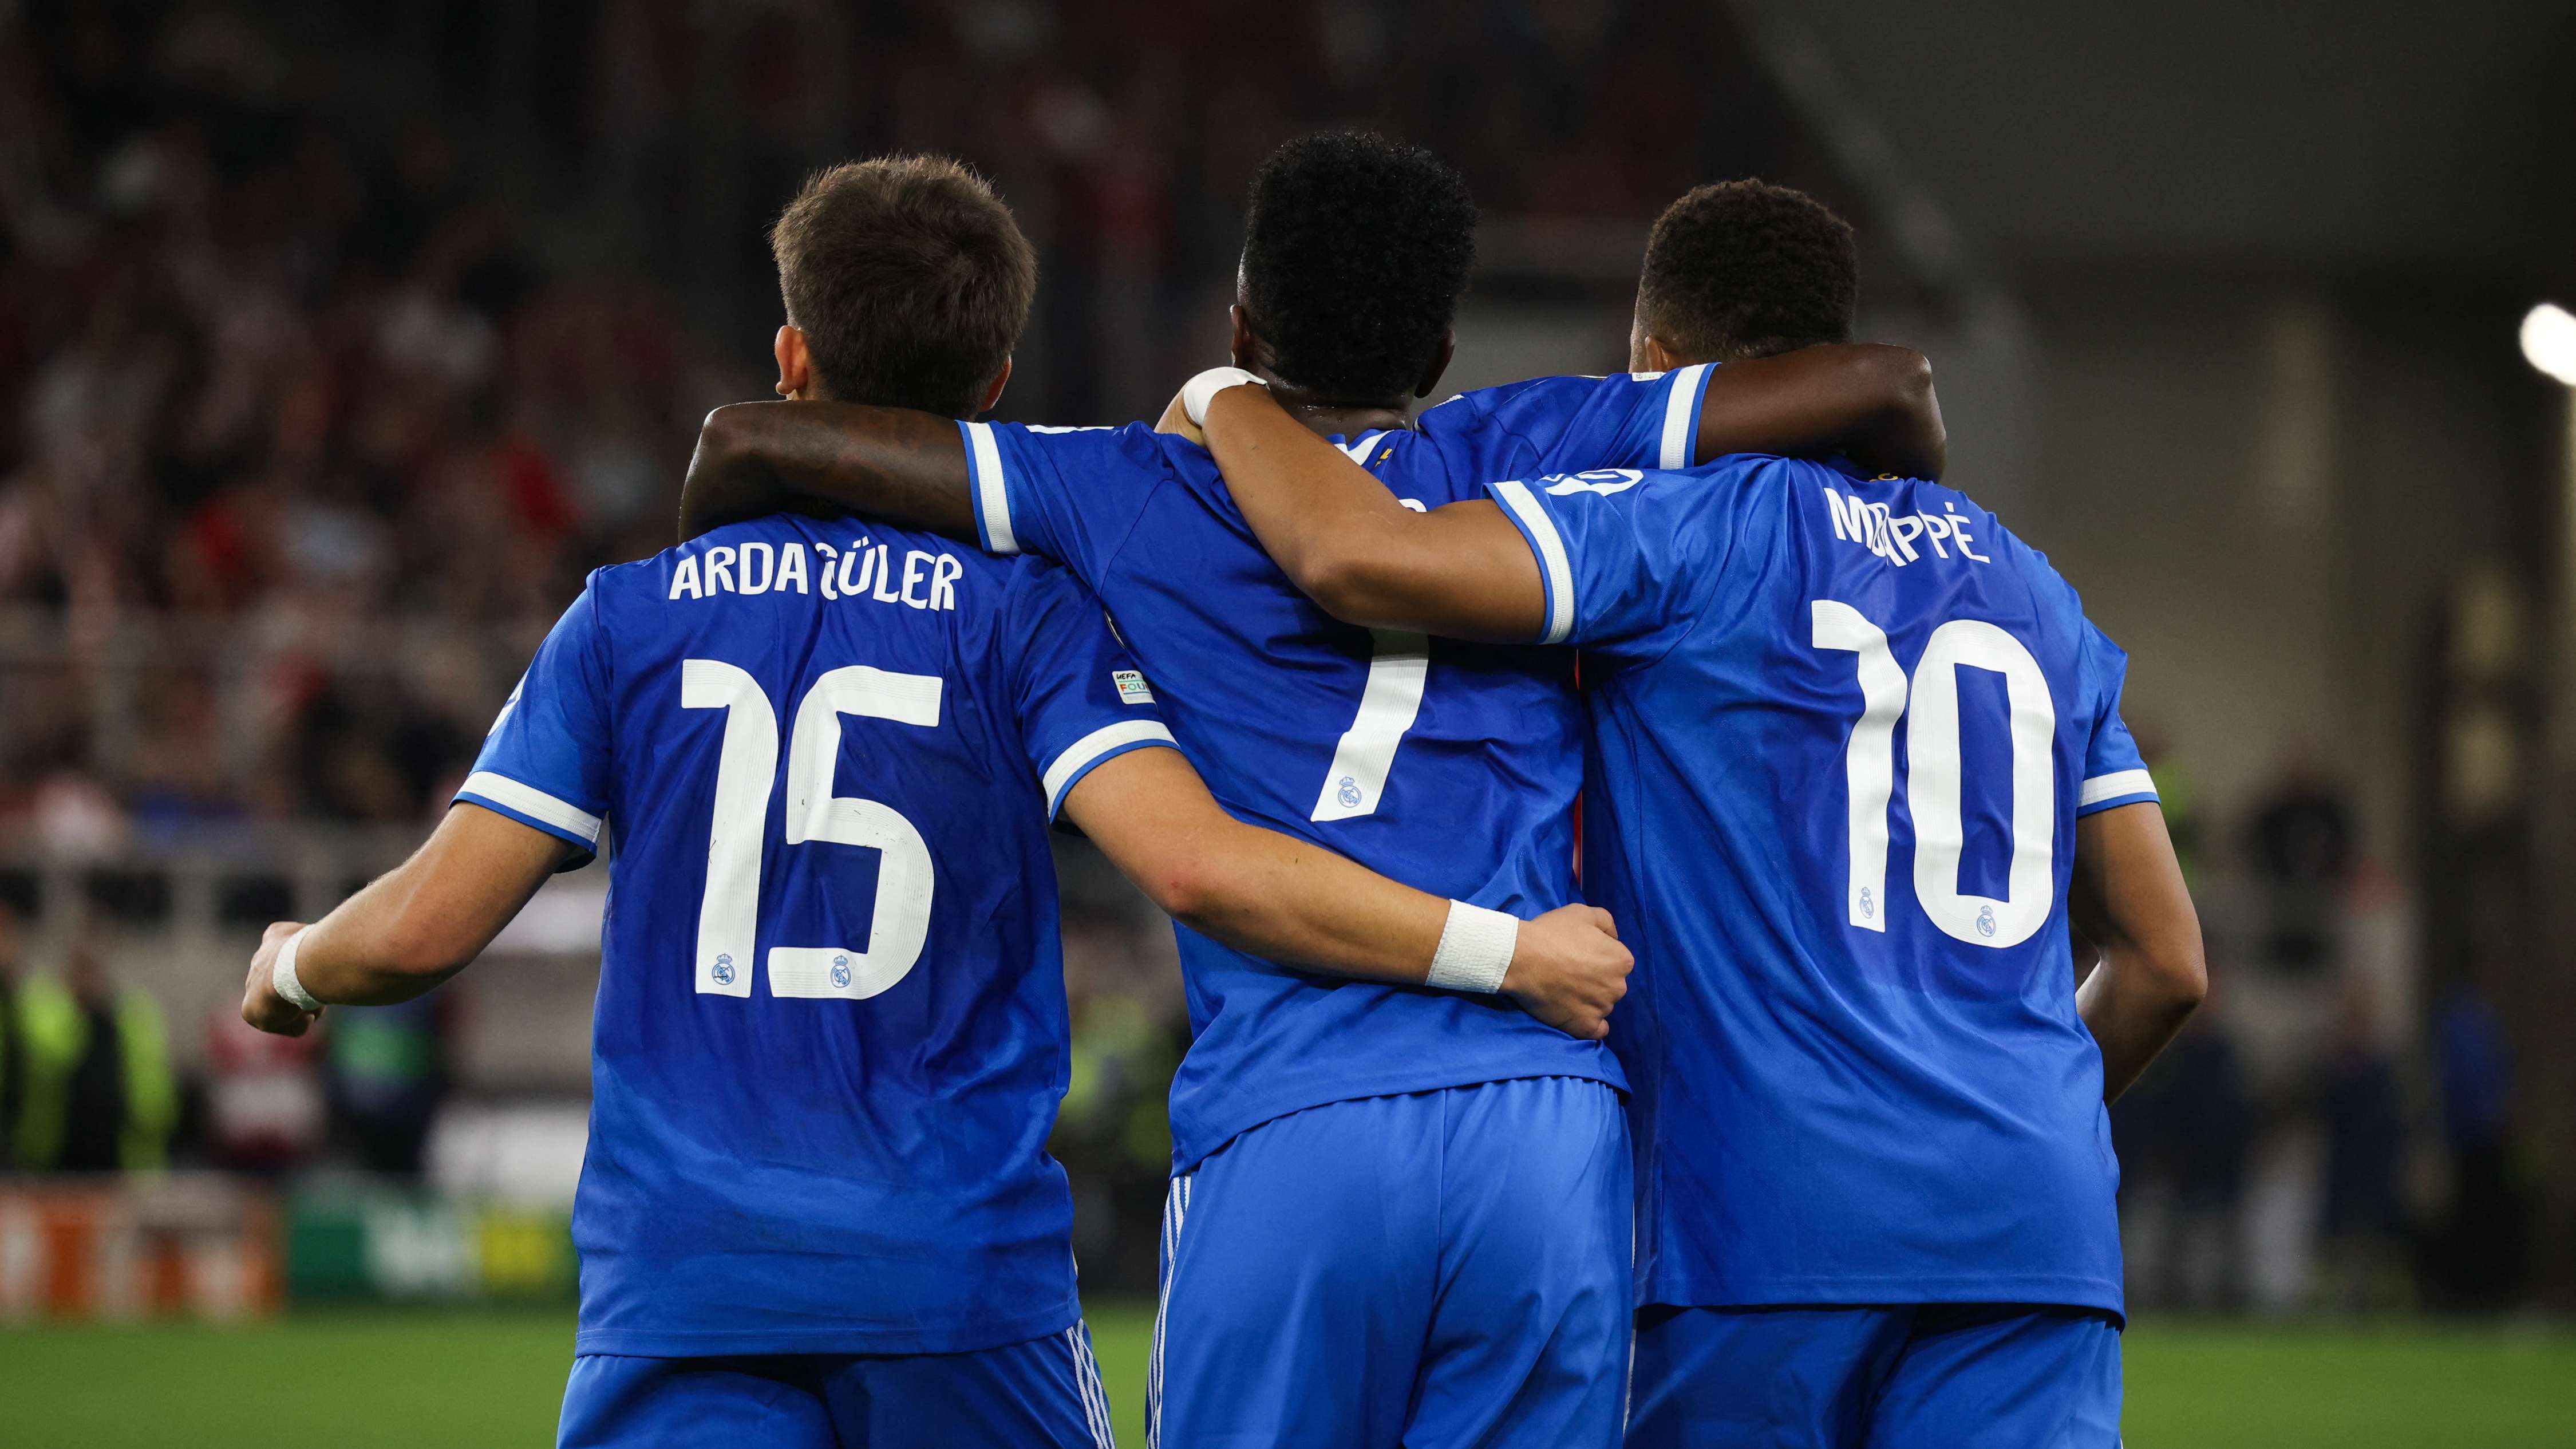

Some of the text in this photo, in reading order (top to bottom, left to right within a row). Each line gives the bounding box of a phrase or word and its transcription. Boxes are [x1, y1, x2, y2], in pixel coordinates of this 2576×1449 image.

[669, 536, 963, 611] ARDA GÜLER
[681, 659, 943, 1000] 15
[1811, 599, 2056, 949] 10
